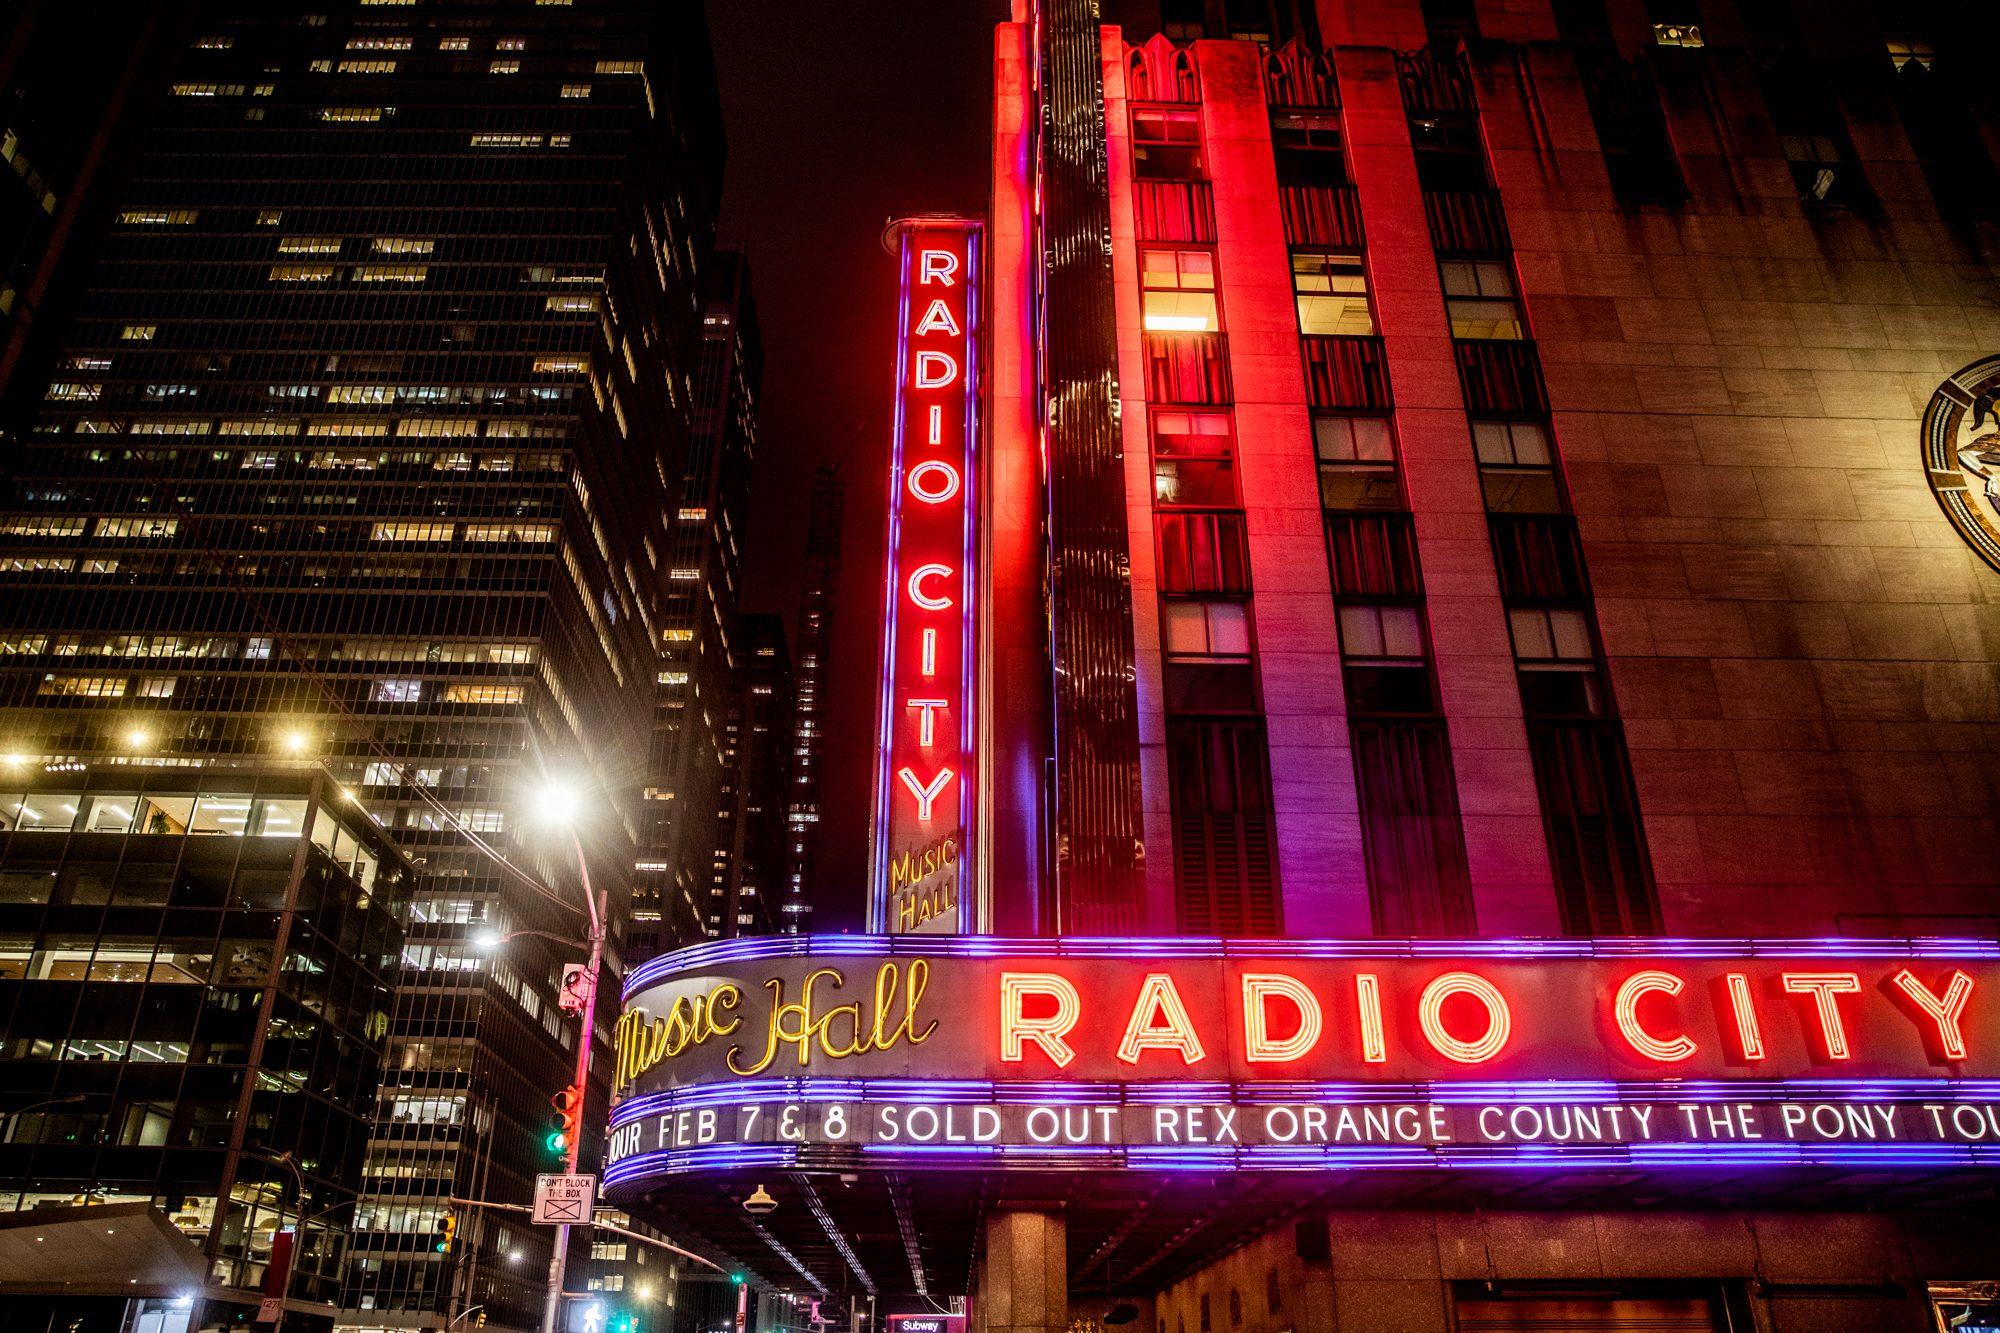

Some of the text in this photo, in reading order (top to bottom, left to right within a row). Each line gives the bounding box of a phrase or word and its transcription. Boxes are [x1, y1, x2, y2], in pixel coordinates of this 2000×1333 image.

[897, 249, 960, 821] RADIO CITY
[891, 840, 956, 896] MUSIC
[899, 884, 955, 934] HALL
[726, 958, 938, 1076] Hall
[1000, 968, 1975, 1069] RADIO CITY
[608, 1121, 642, 1165] OUR
[658, 1109, 716, 1149] FEB
[742, 1105, 760, 1141] 7
[780, 1105, 801, 1141] &
[823, 1105, 848, 1140] 8
[877, 1105, 1001, 1143] SOLD
[1026, 1106, 1118, 1143] OUT
[1155, 1106, 1239, 1143] REX
[1264, 1106, 1451, 1143] ORANGE
[1478, 1104, 1652, 1141] COUNTY
[1678, 1104, 1762, 1139] THE
[1781, 1103, 1896, 1139] PONY
[541, 1178, 590, 1188] DON'T BLOCK
[549, 1188, 581, 1198] THE BOX
[902, 1320, 938, 1331] Subway
